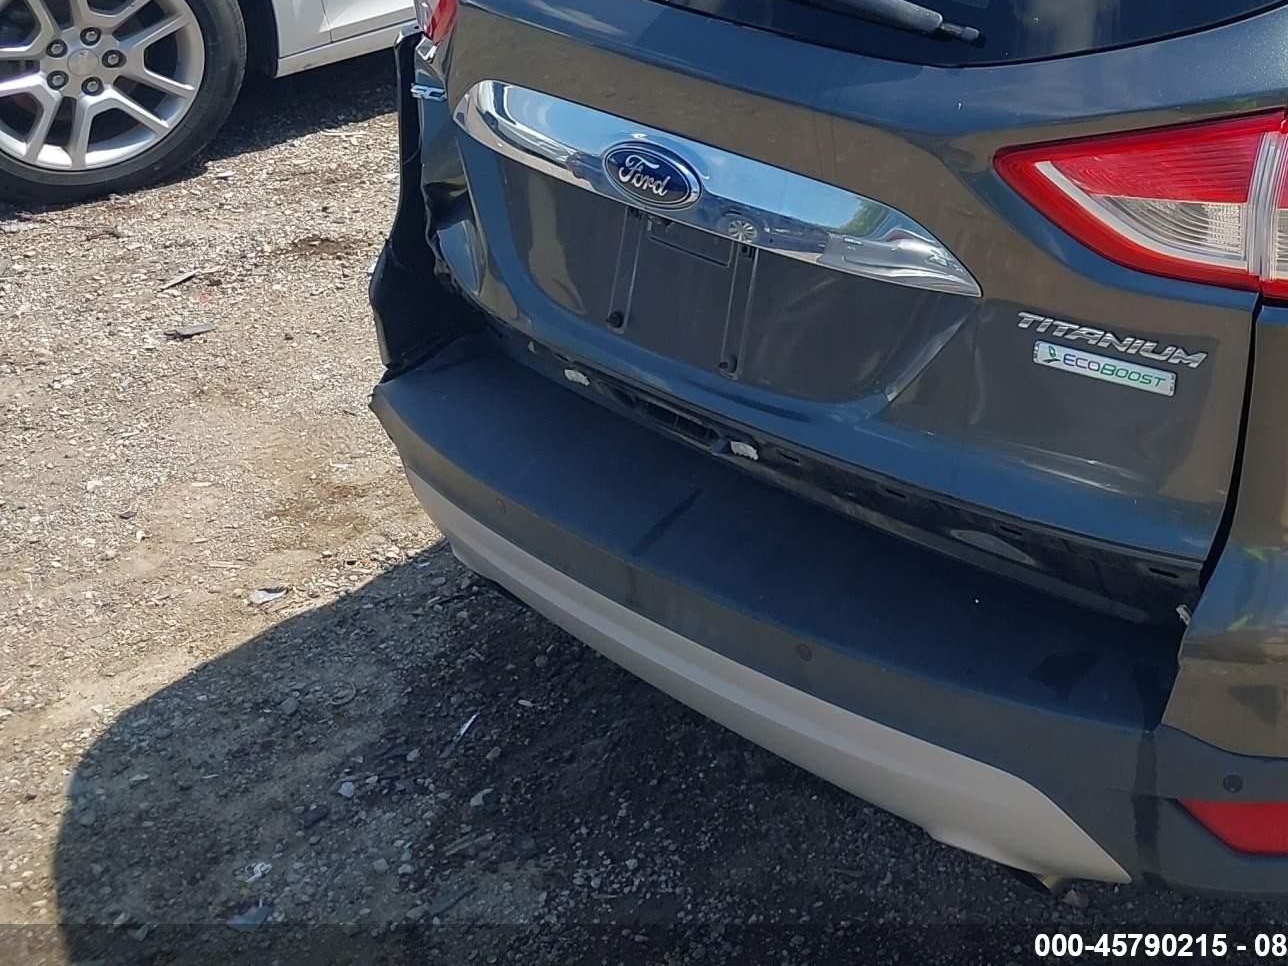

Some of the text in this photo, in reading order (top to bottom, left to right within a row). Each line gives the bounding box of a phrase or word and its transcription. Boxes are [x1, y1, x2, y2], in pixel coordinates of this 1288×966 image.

[618, 154, 672, 197] Ford
[1017, 311, 1208, 369] TITANIUM
[1063, 353, 1166, 388] ECOBOOST
